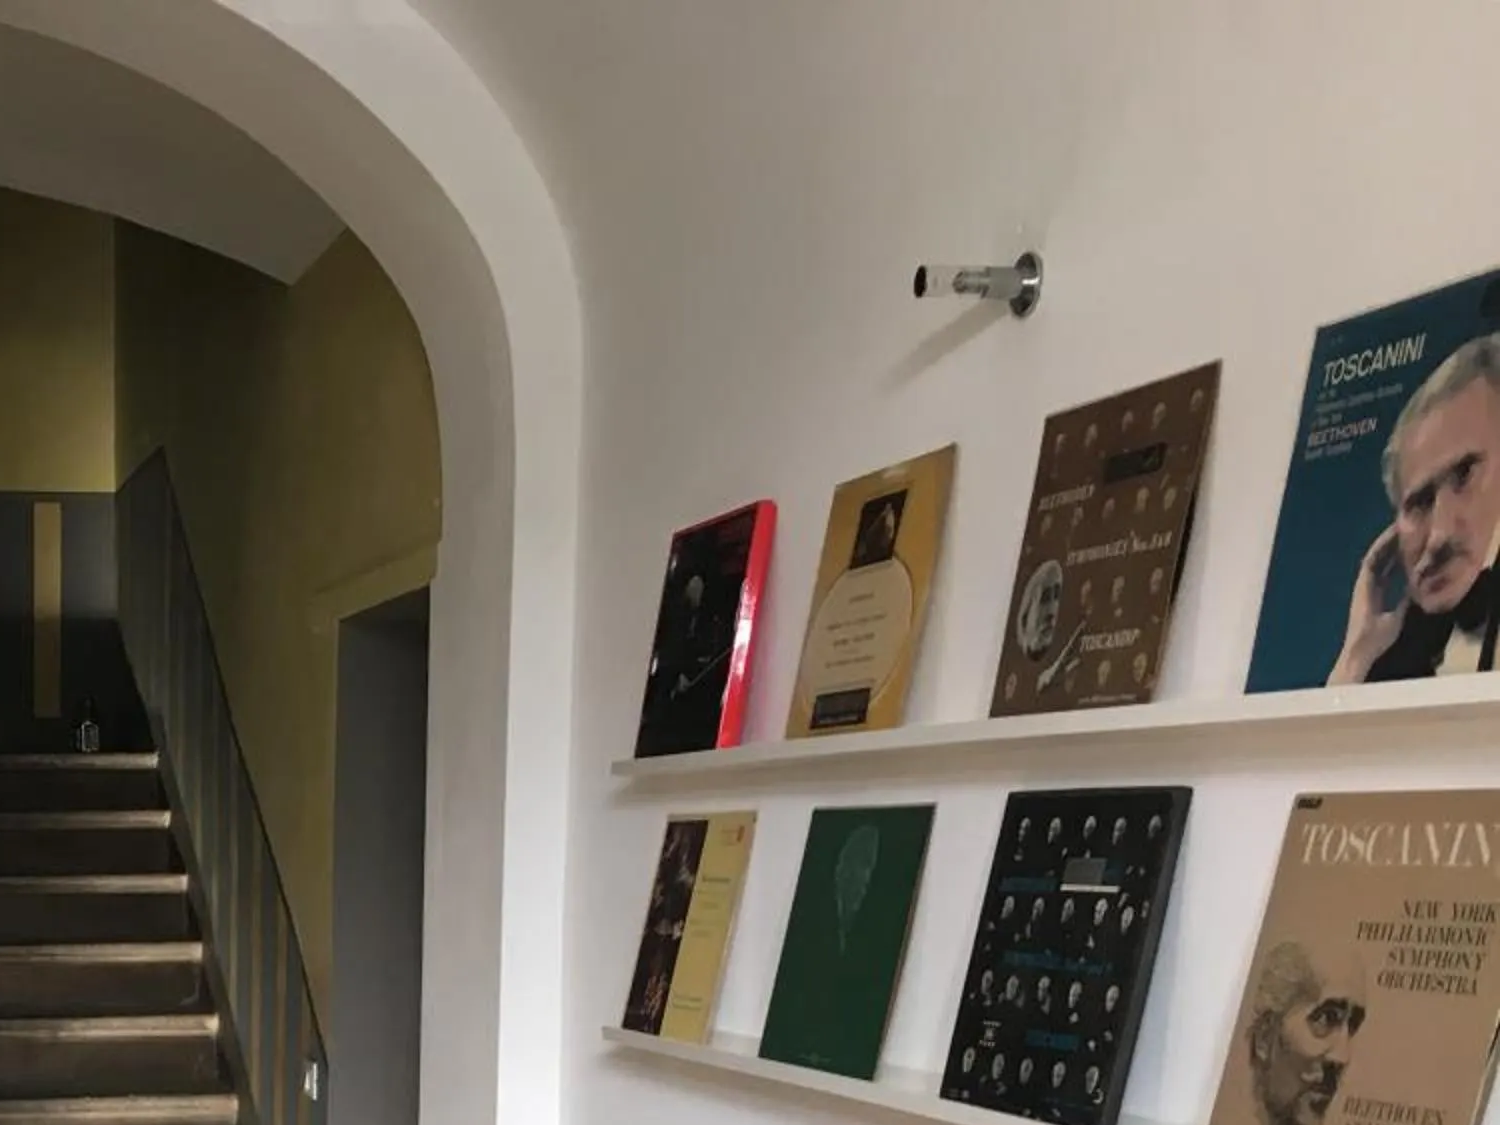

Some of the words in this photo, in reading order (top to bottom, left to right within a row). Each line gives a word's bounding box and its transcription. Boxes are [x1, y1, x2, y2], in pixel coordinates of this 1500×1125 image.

[1323, 332, 1427, 387] TOSCANINI
[1301, 821, 1500, 866] TOSCANIN
[1402, 900, 1442, 920] NEW
[1451, 902, 1497, 924] YORK
[1356, 920, 1495, 946] PHILHARMONIC
[1387, 946, 1486, 972] SYMPHONY
[1376, 969, 1478, 996] ORCHESTRA
